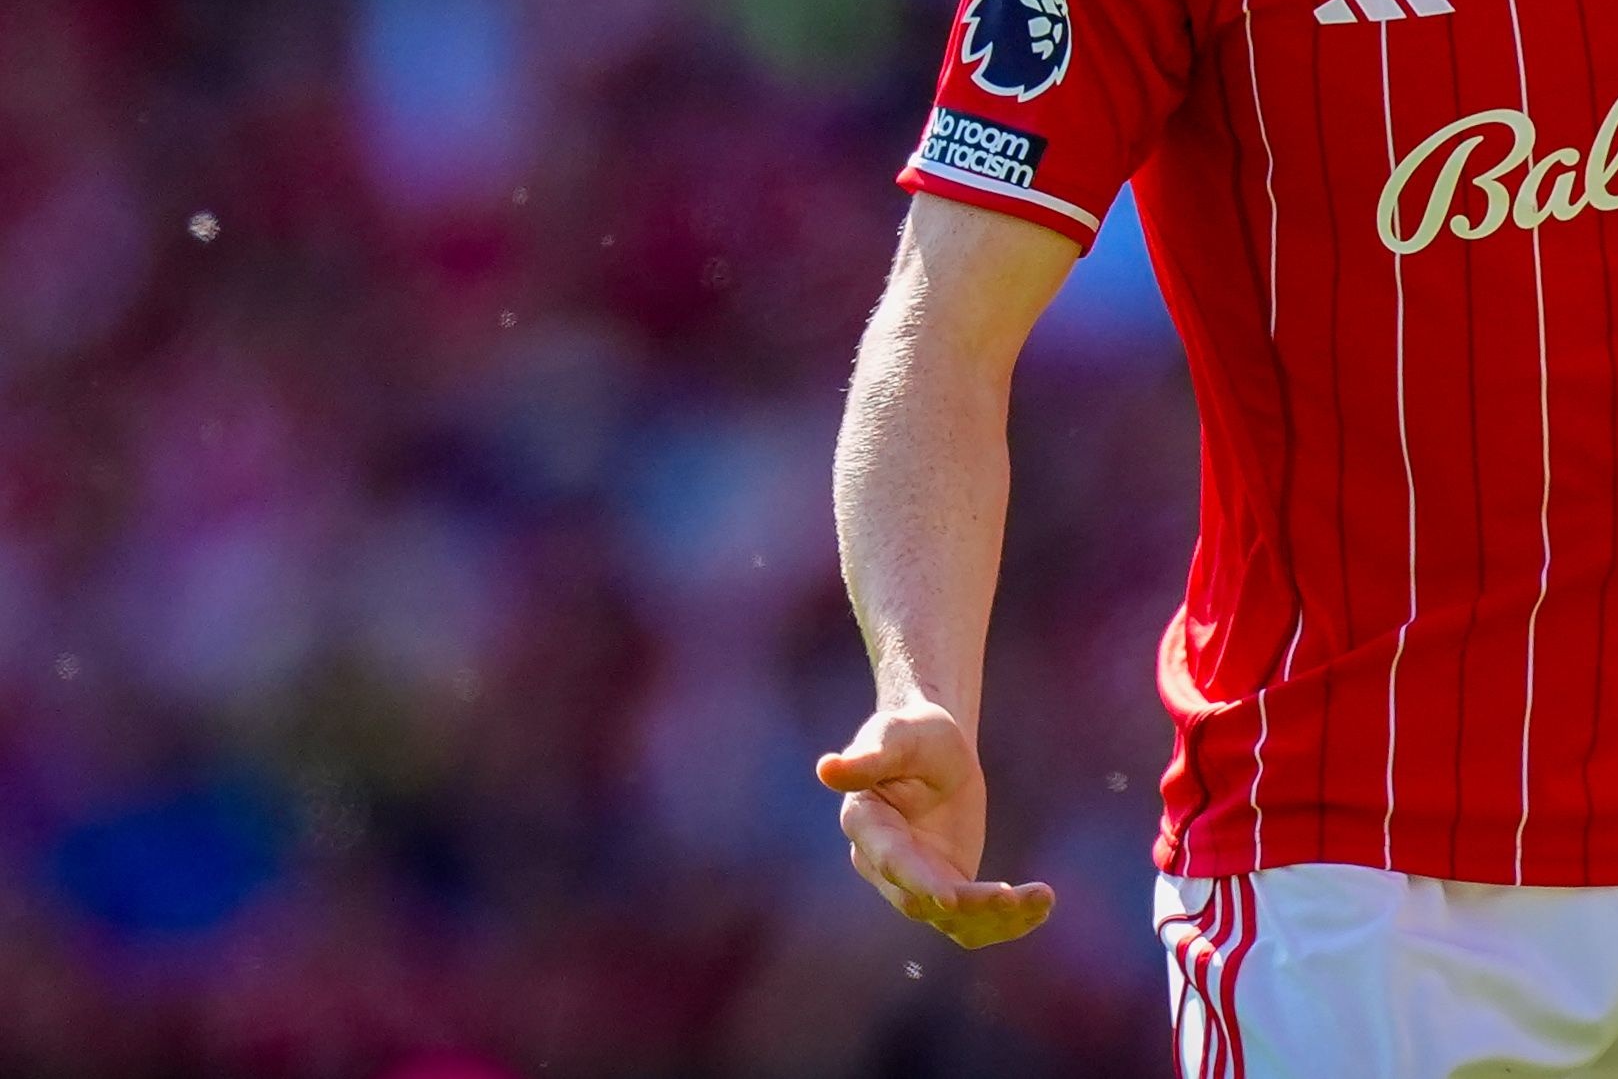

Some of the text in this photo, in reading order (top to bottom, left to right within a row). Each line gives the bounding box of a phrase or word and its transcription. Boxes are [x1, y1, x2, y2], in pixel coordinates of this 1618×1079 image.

[932, 107, 1030, 160] No room
[920, 137, 1034, 188] or racism
